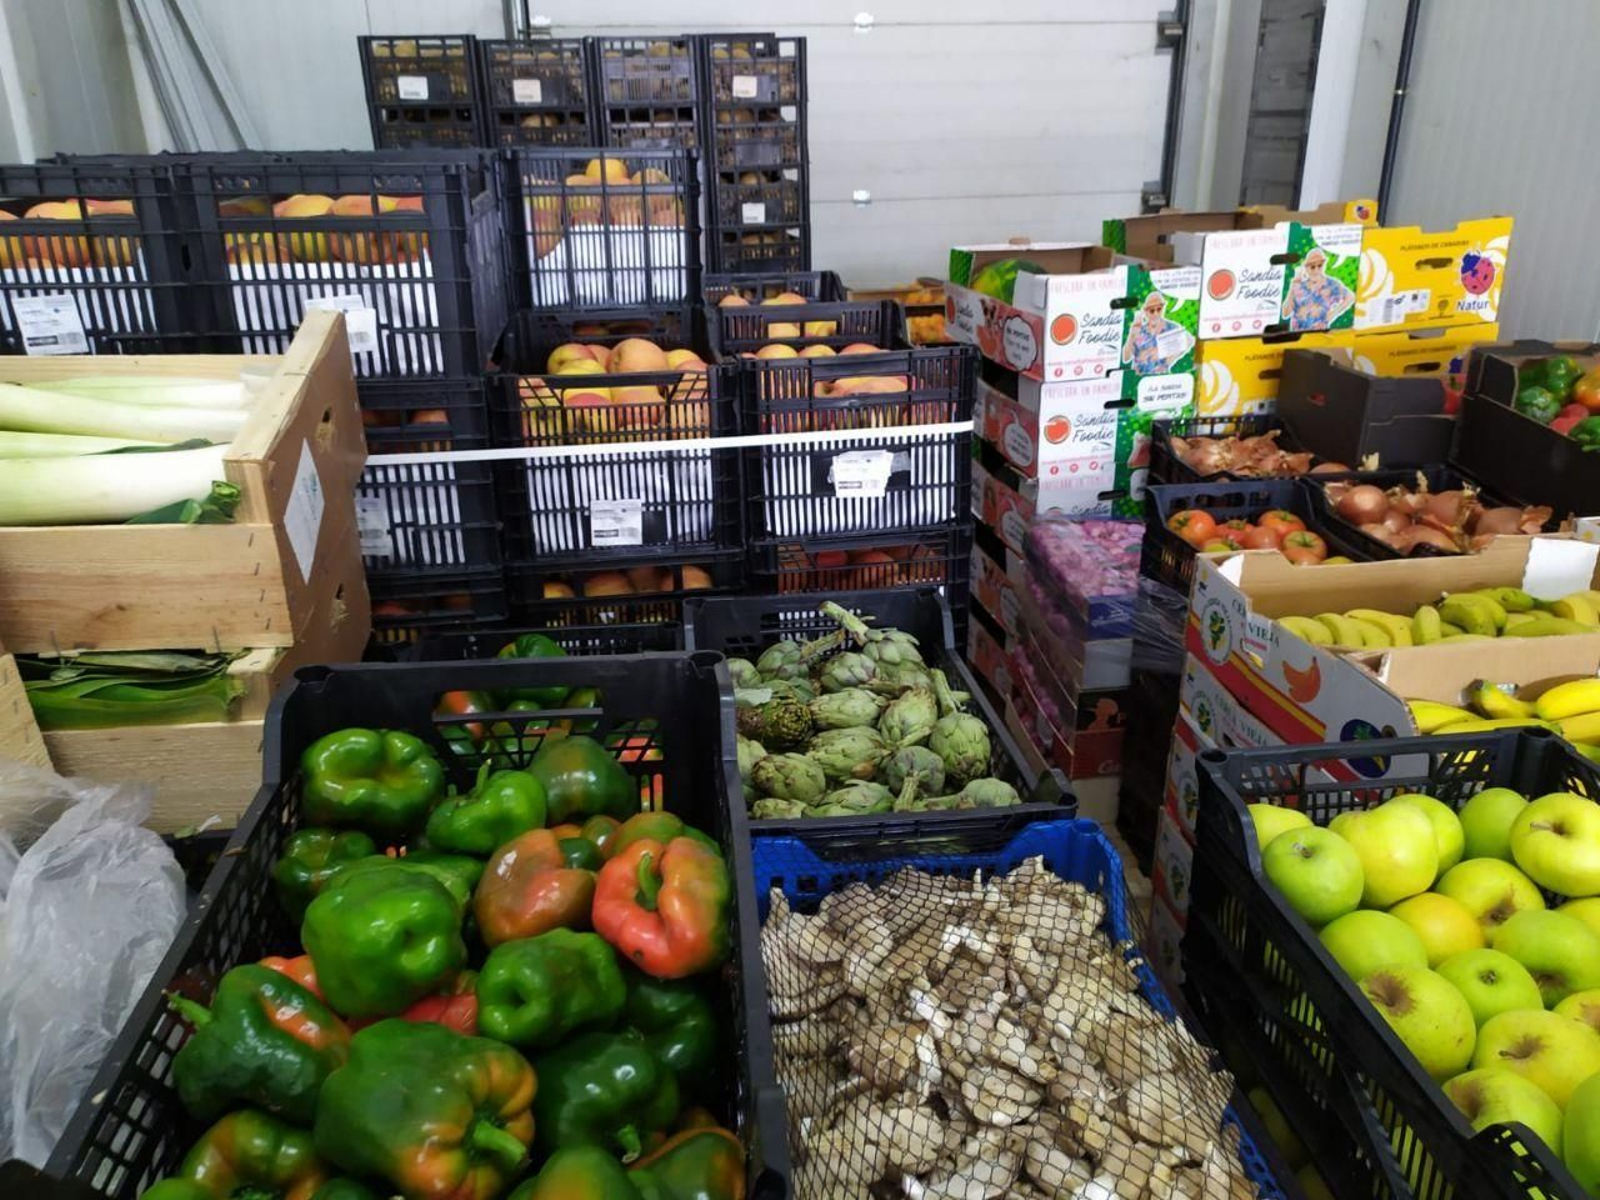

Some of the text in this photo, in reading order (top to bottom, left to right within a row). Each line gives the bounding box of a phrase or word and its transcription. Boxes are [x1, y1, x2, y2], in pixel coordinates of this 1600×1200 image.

[1236, 283, 1280, 299] Foodie
[1457, 300, 1490, 311] Natur
[1078, 328, 1120, 344] Foodie
[1072, 426, 1115, 443] Foodie
[1248, 622, 1280, 648] VIEJA
